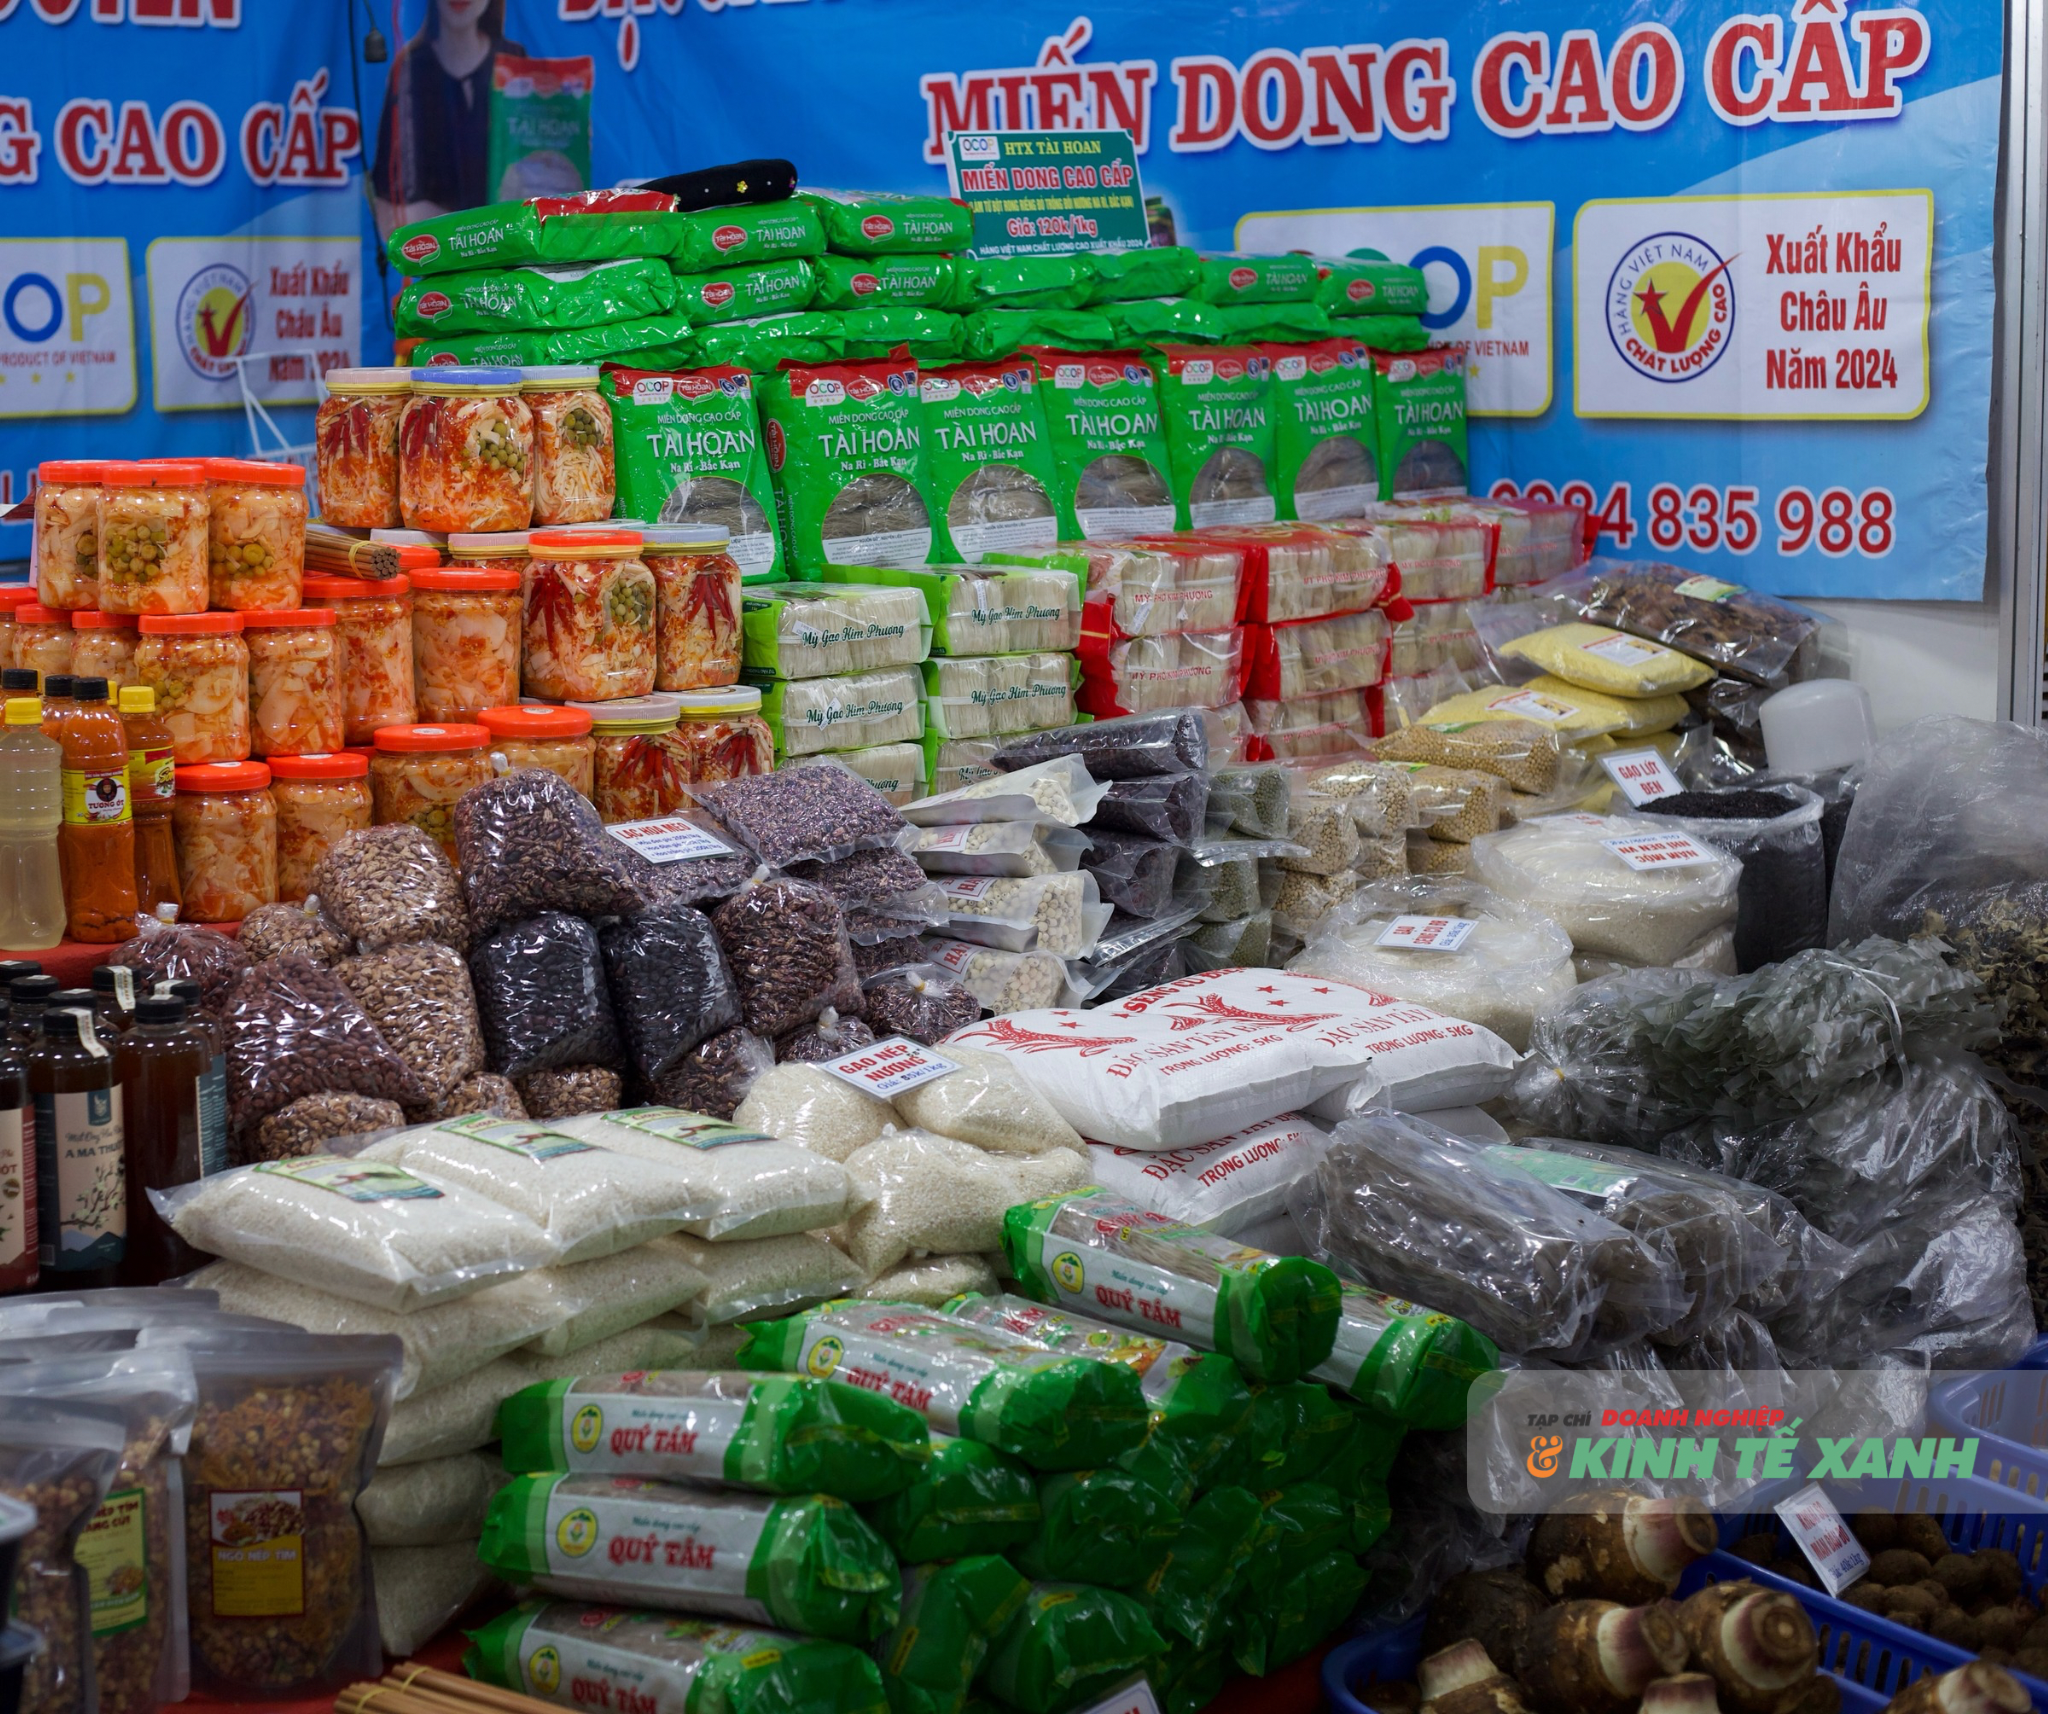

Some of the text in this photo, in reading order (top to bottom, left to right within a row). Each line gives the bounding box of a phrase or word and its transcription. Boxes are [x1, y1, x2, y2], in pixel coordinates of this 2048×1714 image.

[924, 22, 1152, 160] MIẾN
[1174, 42, 1450, 147] DONG
[1477, 27, 1682, 134] CAO
[1709, 0, 1926, 120] CẤP
[57, 104, 224, 183] CAO
[244, 71, 361, 183] CẤP
[962, 138, 994, 150] OCOP
[1004, 137, 1102, 155] HTX TÀI HOAN
[961, 158, 1134, 191] MIẾN DONG CAO CẤP
[756, 226, 775, 242] TÀI
[776, 226, 806, 241] HOAN
[903, 219, 919, 235] TÀI
[920, 220, 953, 234] HOAN
[1007, 214, 1097, 238] Giá: 120k/1kg
[1017, 243, 1033, 253] NAM
[1075, 241, 1089, 250] CAO
[1765, 221, 1902, 274] Xuất Khẩu
[269, 262, 307, 297] Xuất
[745, 275, 800, 296] TÀI HOAN
[1614, 243, 1710, 336] HÀNG VIỆT NAM
[1780, 281, 1888, 332] Châu Âu
[276, 302, 343, 339] Châu Âu
[1625, 283, 1727, 373] CHẤT LƯỢNG CAO
[52, 352, 66, 366] OF
[69, 350, 117, 365] VIETNAM
[1475, 340, 1530, 357] VIETNAM
[1058, 366, 1083, 378] OCOP
[1766, 347, 1898, 389] Năm 2024
[637, 380, 669, 393] OCOP
[809, 383, 841, 394] OCOP
[657, 410, 742, 424] MIẾN DONG CAO CẤP
[828, 414, 851, 425] MIẾN
[852, 413, 877, 424] DONG
[878, 411, 894, 422] CAO
[943, 406, 966, 418] MIẾN
[967, 406, 991, 416] DONG
[991, 405, 1009, 414] CAO
[1188, 405, 1266, 431] TÀI HOAN
[1294, 394, 1373, 423] TÀI HOAN
[1394, 400, 1464, 424] TÀI HOAN
[934, 420, 1037, 450] TÀI HOAN
[1065, 409, 1158, 436] TÀI HOAN
[646, 427, 684, 458] TÀI
[686, 429, 756, 456] HOAN
[818, 426, 921, 458] TÀI HOAN
[1651, 486, 1758, 551] 835
[1778, 489, 1893, 554] 988
[988, 608, 1002, 625] Gạo
[1004, 606, 1022, 619] Kim
[1025, 605, 1061, 621] Phượng
[822, 629, 840, 647] Gạo
[841, 627, 864, 641] Kim
[867, 624, 905, 638] Phượng
[989, 688, 1006, 706] Gạo
[1008, 686, 1029, 700] Kim
[1031, 683, 1067, 698] Phượng
[826, 706, 843, 724] Gạo
[845, 703, 864, 718] Kim
[868, 700, 903, 715] Phượng
[1618, 760, 1661, 781] GẠO LỨT
[1639, 780, 1665, 796] ĐEN
[616, 828, 643, 840] LẠC
[641, 825, 667, 836] HOA
[1617, 845, 1639, 855] VN
[1638, 841, 1667, 852] ĐEN
[1350, 1016, 1397, 1034] SẢN
[1387, 1008, 1434, 1025] TÂY
[1365, 1024, 1474, 1054] TRỌNG LƯỢNG: 5KG
[838, 1044, 909, 1073] GẠO NẾP
[1106, 1028, 1239, 1079] ĐẶC SẢN TÂY
[1159, 1034, 1284, 1077] TRỌNG LƯỢNG: 5KG
[864, 1055, 928, 1082] NƯƠNG
[65, 1149, 96, 1159] A MA
[1141, 1150, 1195, 1181] ĐẶC
[1197, 1155, 1245, 1187] TRỌNG
[1094, 1284, 1137, 1313] QUÝ
[607, 1532, 660, 1566] QUÝ
